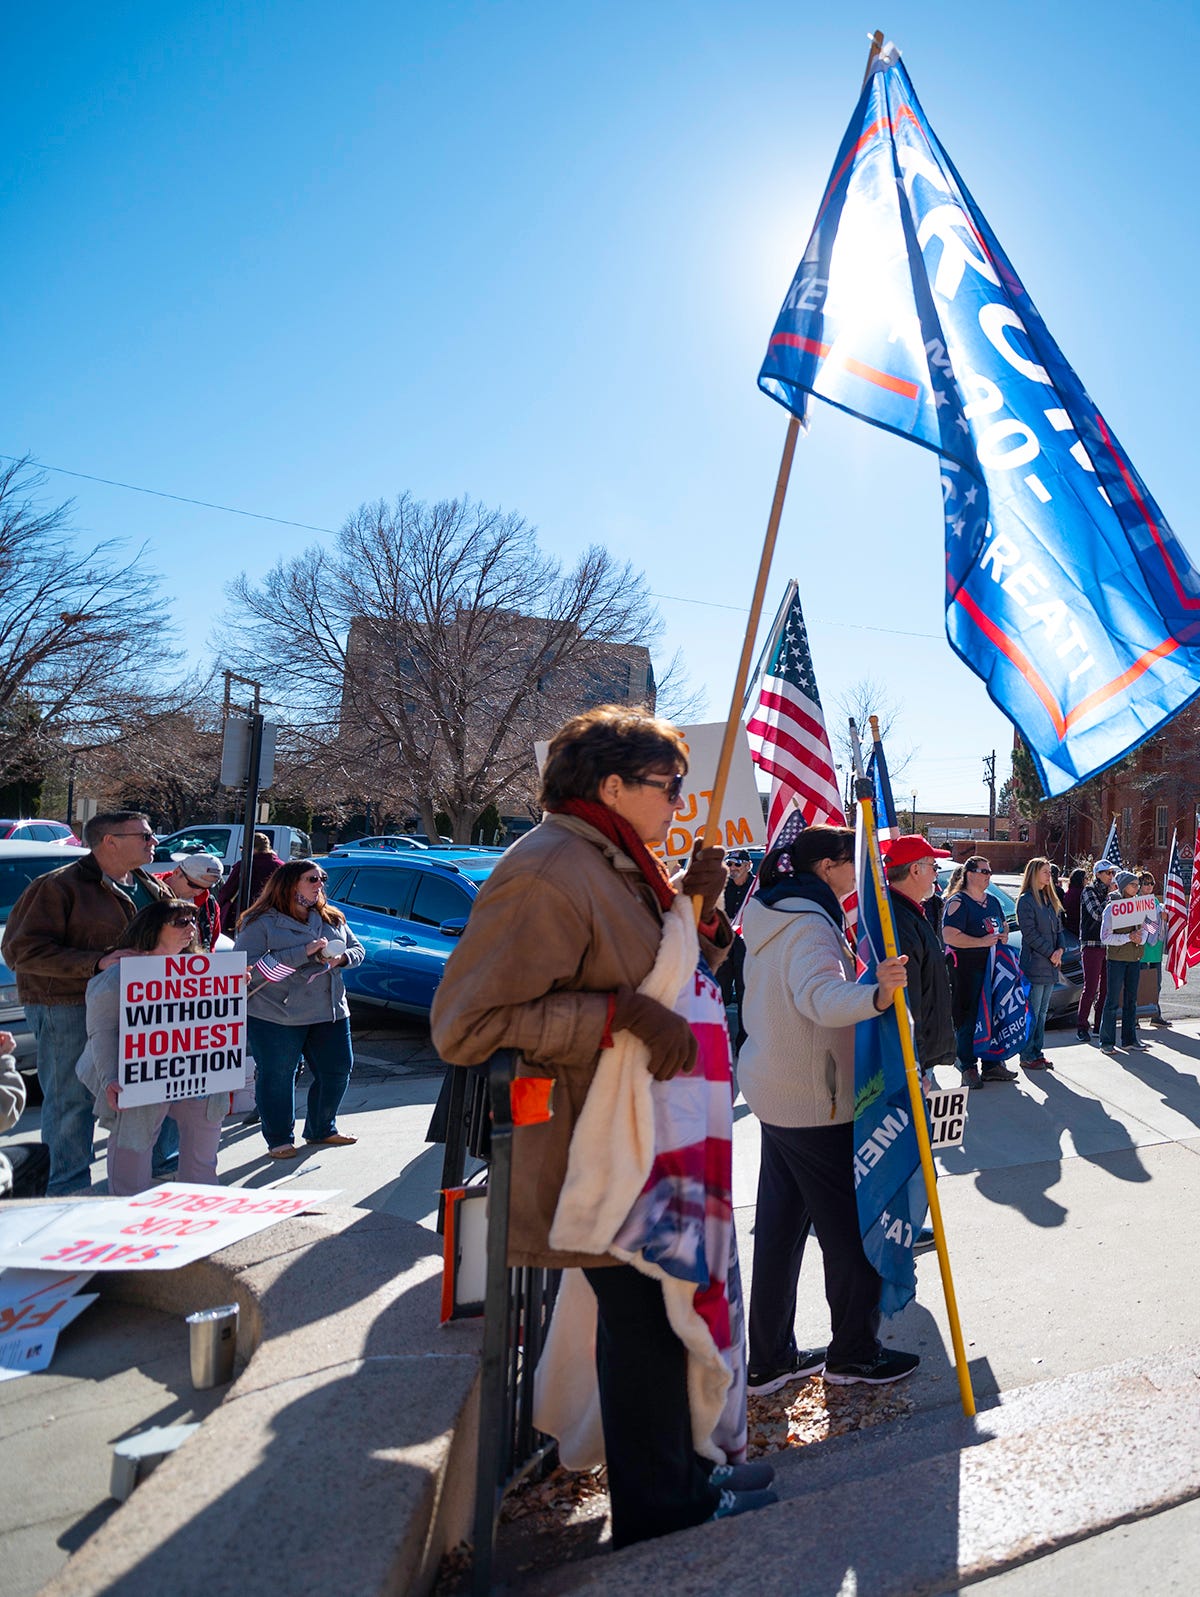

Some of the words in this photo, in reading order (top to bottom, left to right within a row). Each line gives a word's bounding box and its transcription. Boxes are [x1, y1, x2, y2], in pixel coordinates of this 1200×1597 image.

[1111, 901, 1134, 916] GOD
[1135, 898, 1155, 912] WINS
[165, 955, 210, 977] NO
[126, 974, 243, 1003] CONSENT
[125, 997, 243, 1027] WITHOUT
[124, 1022, 244, 1060] HONEST
[124, 1048, 242, 1085] ELECTION
[128, 1191, 314, 1214] REPUBLIC
[120, 1216, 220, 1236] OUR
[40, 1239, 178, 1264] SAVE
